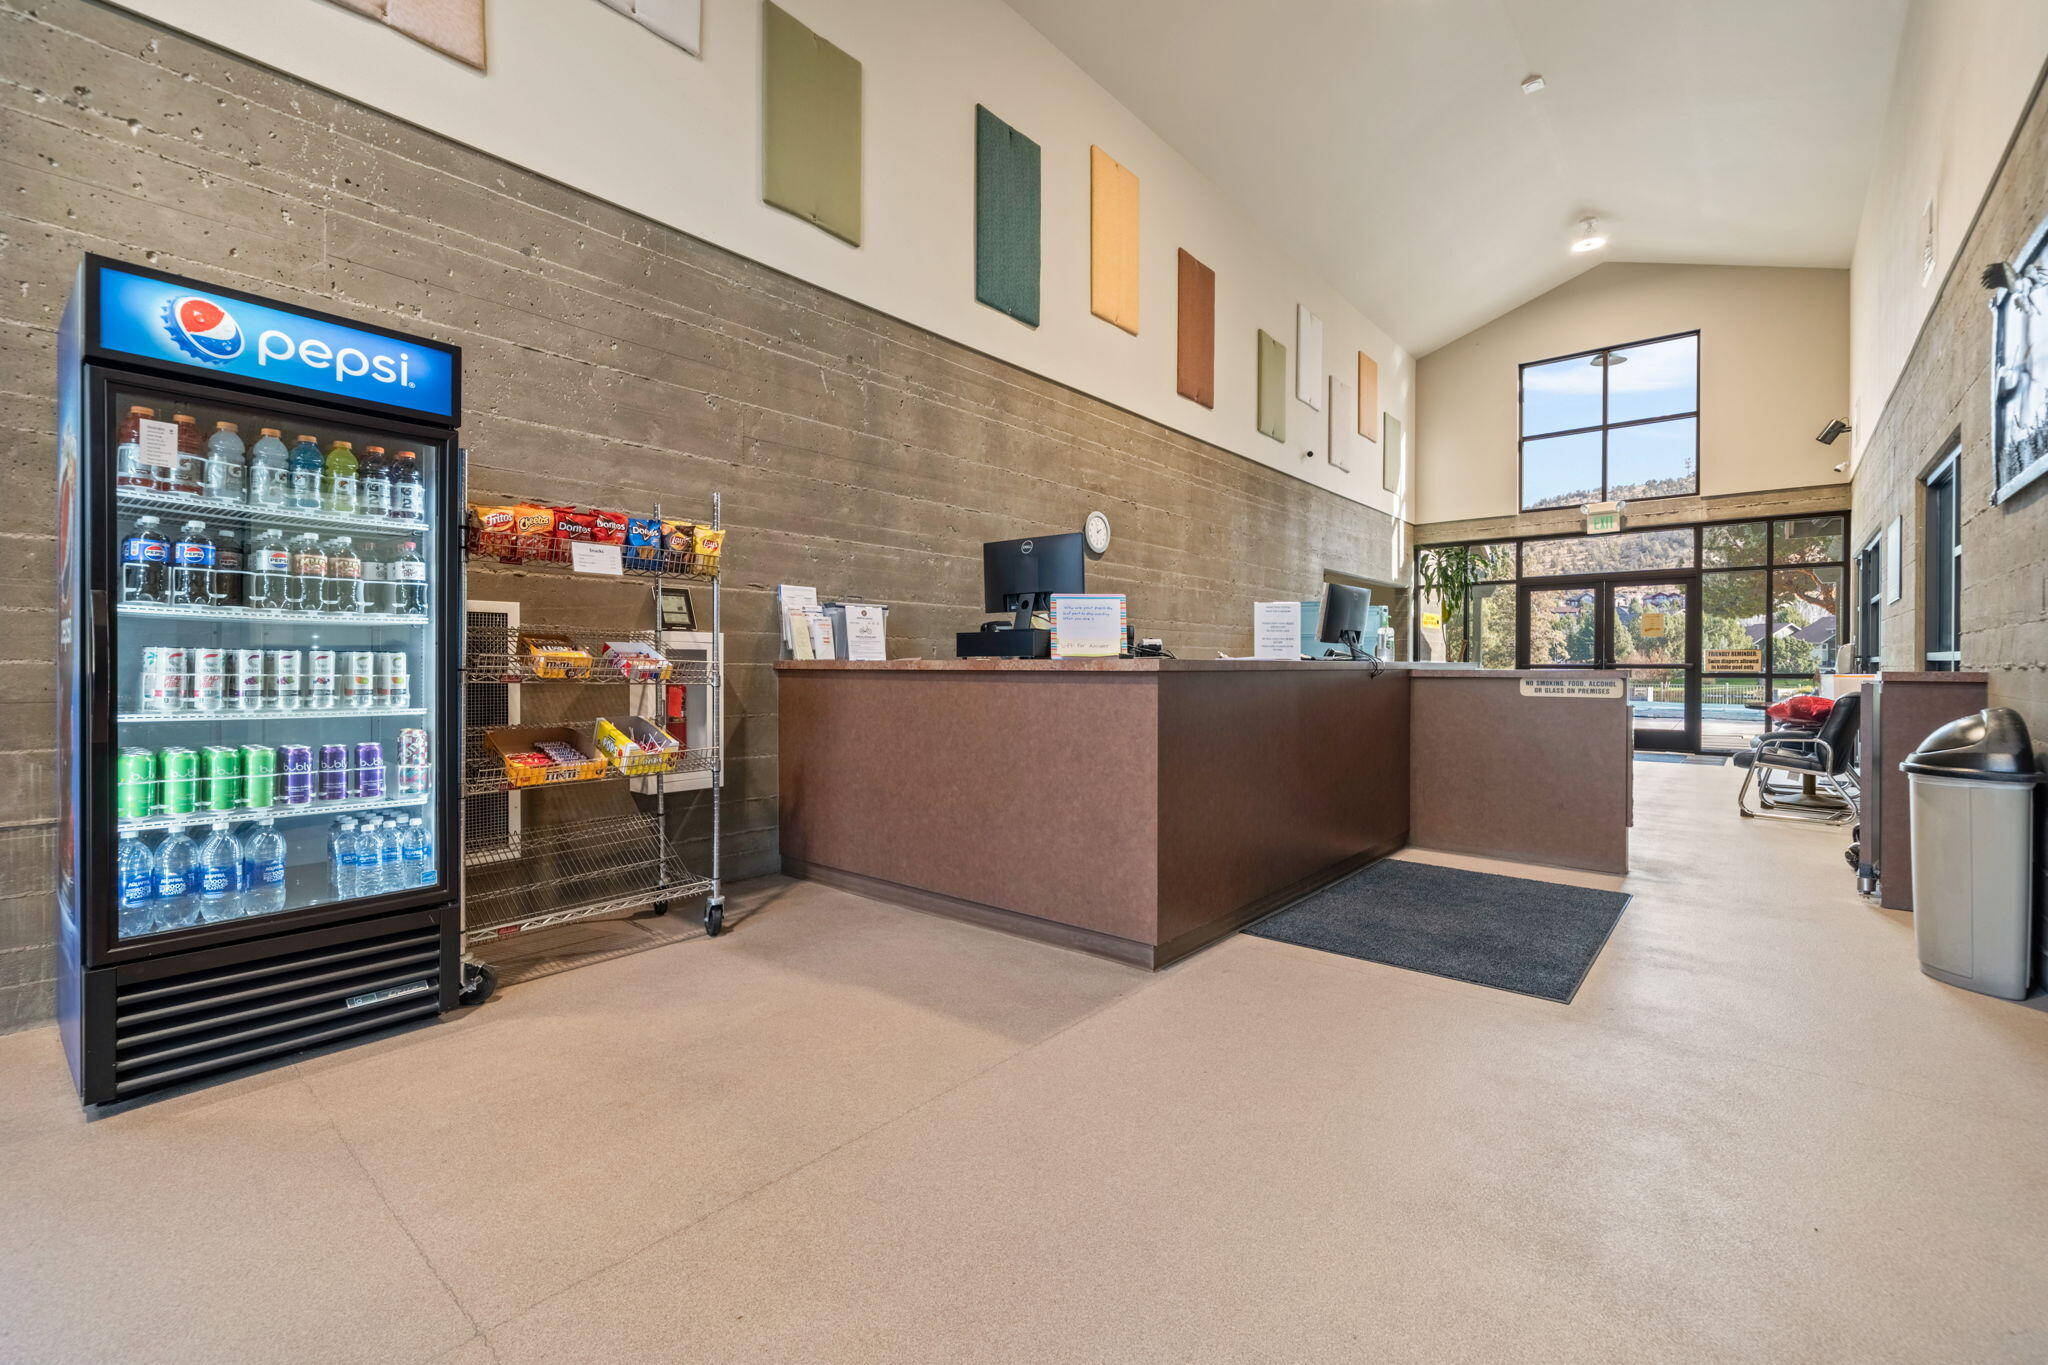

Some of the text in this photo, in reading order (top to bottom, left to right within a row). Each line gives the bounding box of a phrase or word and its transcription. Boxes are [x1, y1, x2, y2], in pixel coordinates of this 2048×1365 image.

[258, 329, 409, 387] pepsi
[485, 512, 513, 525] Fritos
[519, 515, 551, 531] Cheetos
[596, 518, 626, 531] Doritos
[1593, 515, 1614, 530] EXIT
[558, 521, 592, 534] Doritos
[283, 762, 312, 773] bubly
[321, 760, 347, 769] bubly
